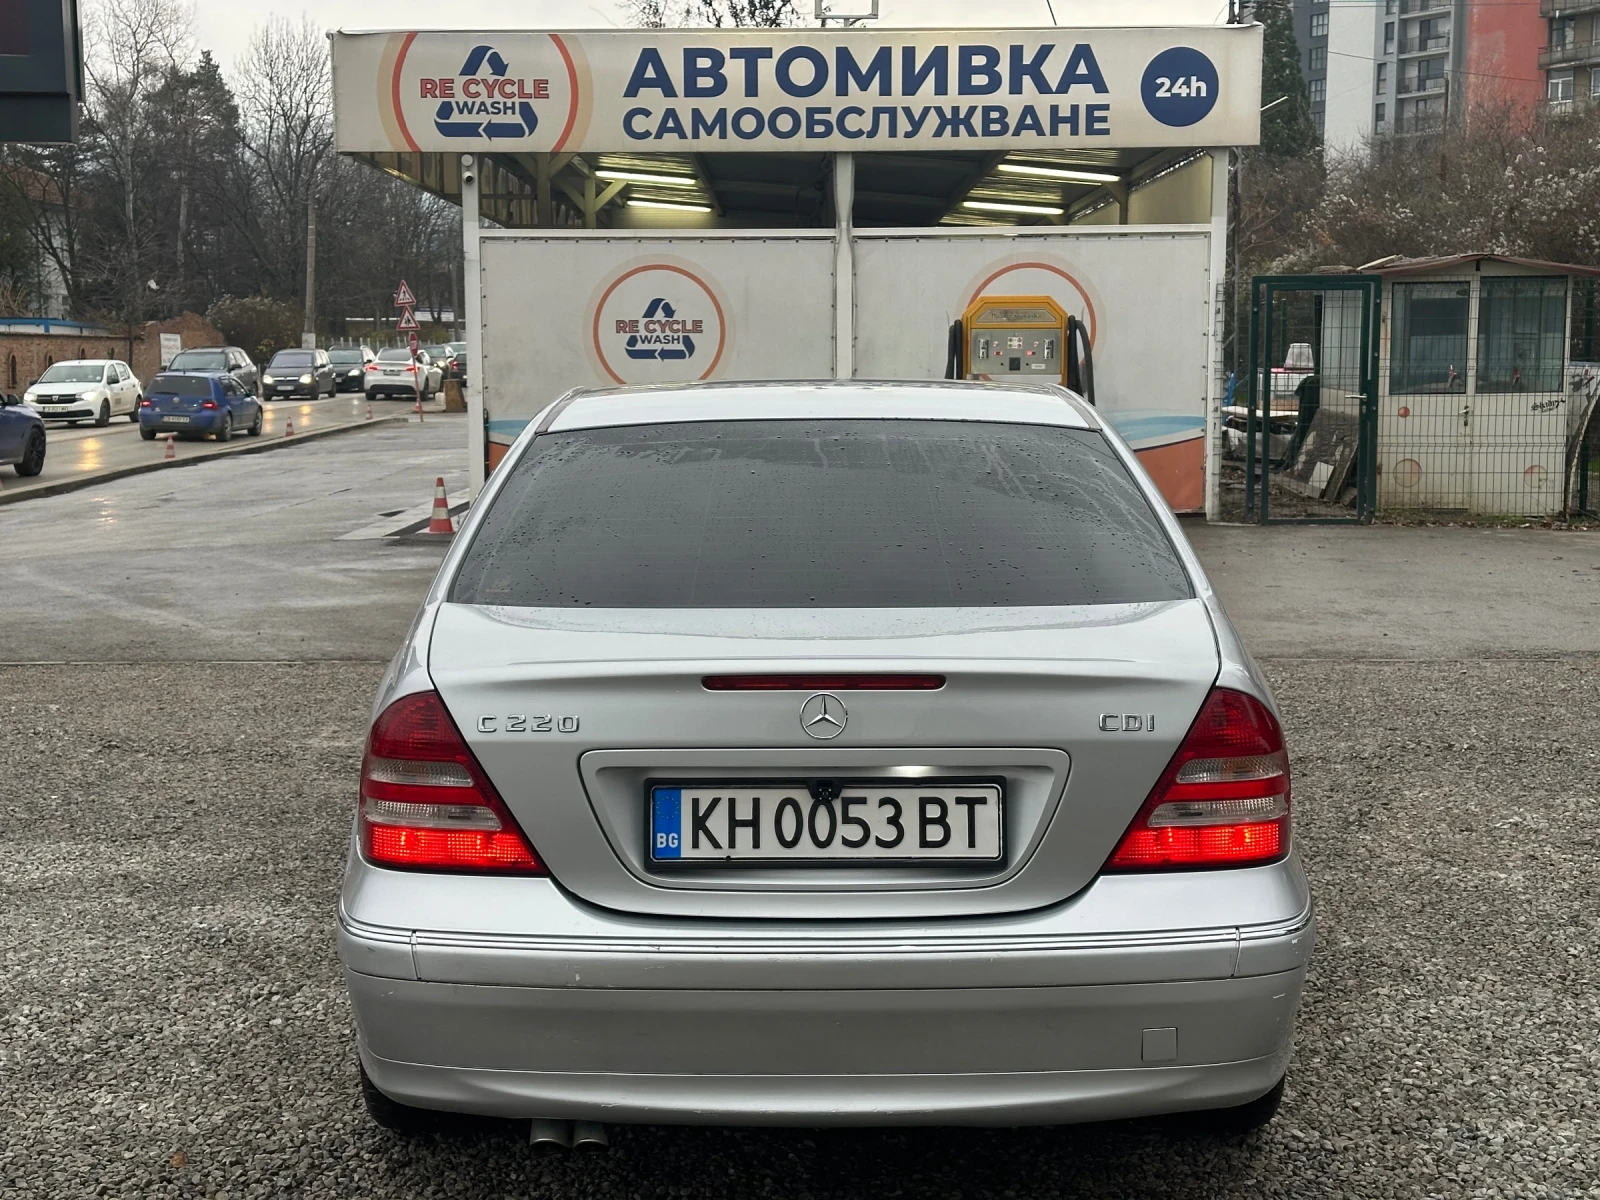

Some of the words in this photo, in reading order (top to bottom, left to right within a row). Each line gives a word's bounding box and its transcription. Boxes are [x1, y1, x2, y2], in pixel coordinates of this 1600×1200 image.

[623, 43, 1110, 98] АВТОМИВКА
[420, 78, 455, 98] RE
[462, 78, 549, 99] CYCLE
[1155, 77, 1207, 97] 24h
[455, 100, 516, 115] WASH
[623, 103, 1111, 140] САМООБСЛУЖВАНЕ
[615, 319, 640, 334] RE
[644, 319, 703, 334] CYCLE
[639, 335, 681, 345] WASH
[477, 714, 498, 733] C
[505, 714, 580, 733] 220
[1099, 713, 1155, 731] CDI
[656, 832, 679, 848] BG
